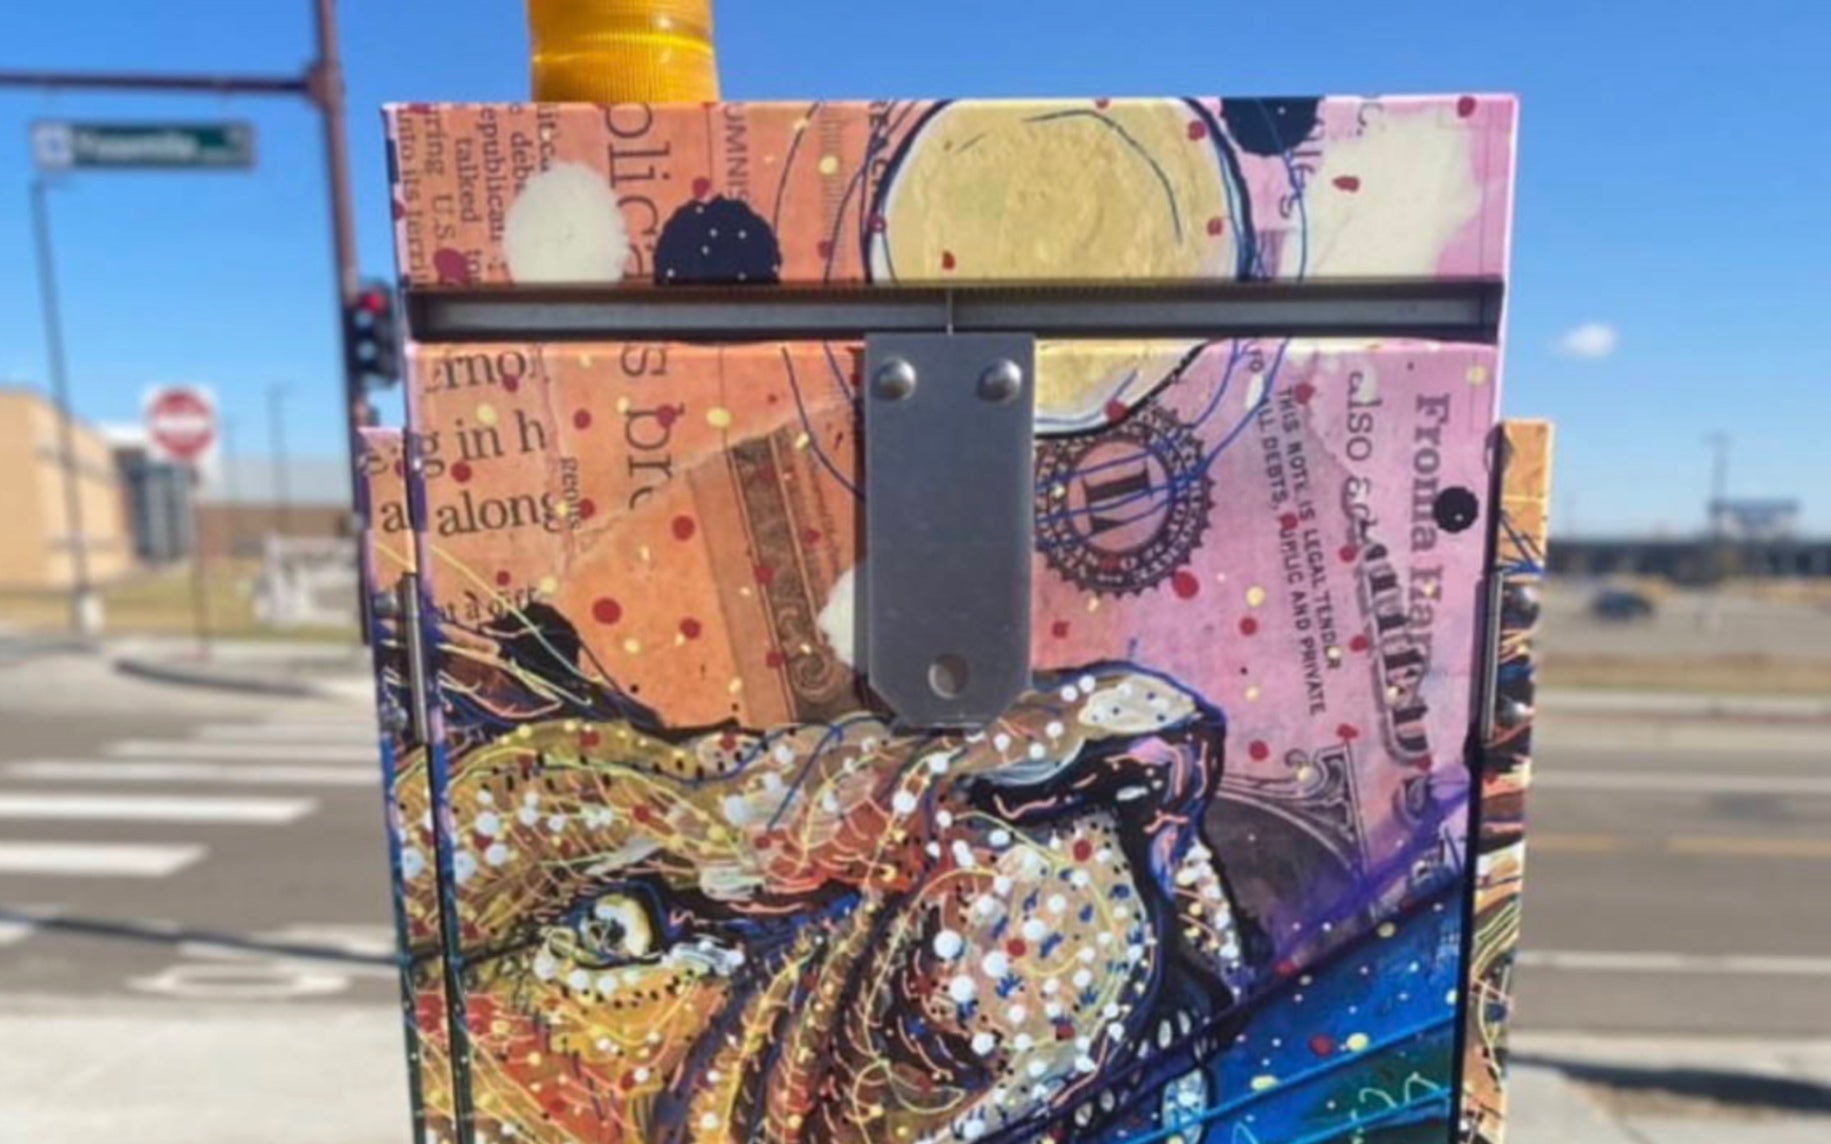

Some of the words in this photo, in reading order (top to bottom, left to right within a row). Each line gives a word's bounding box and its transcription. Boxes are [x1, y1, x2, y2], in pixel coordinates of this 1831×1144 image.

[455, 418, 505, 460] in
[1290, 590, 1312, 632] AND
[1302, 528, 1327, 589] LEGAL
[1315, 590, 1343, 669] TENDR
[1299, 635, 1328, 717] PRIVATE
